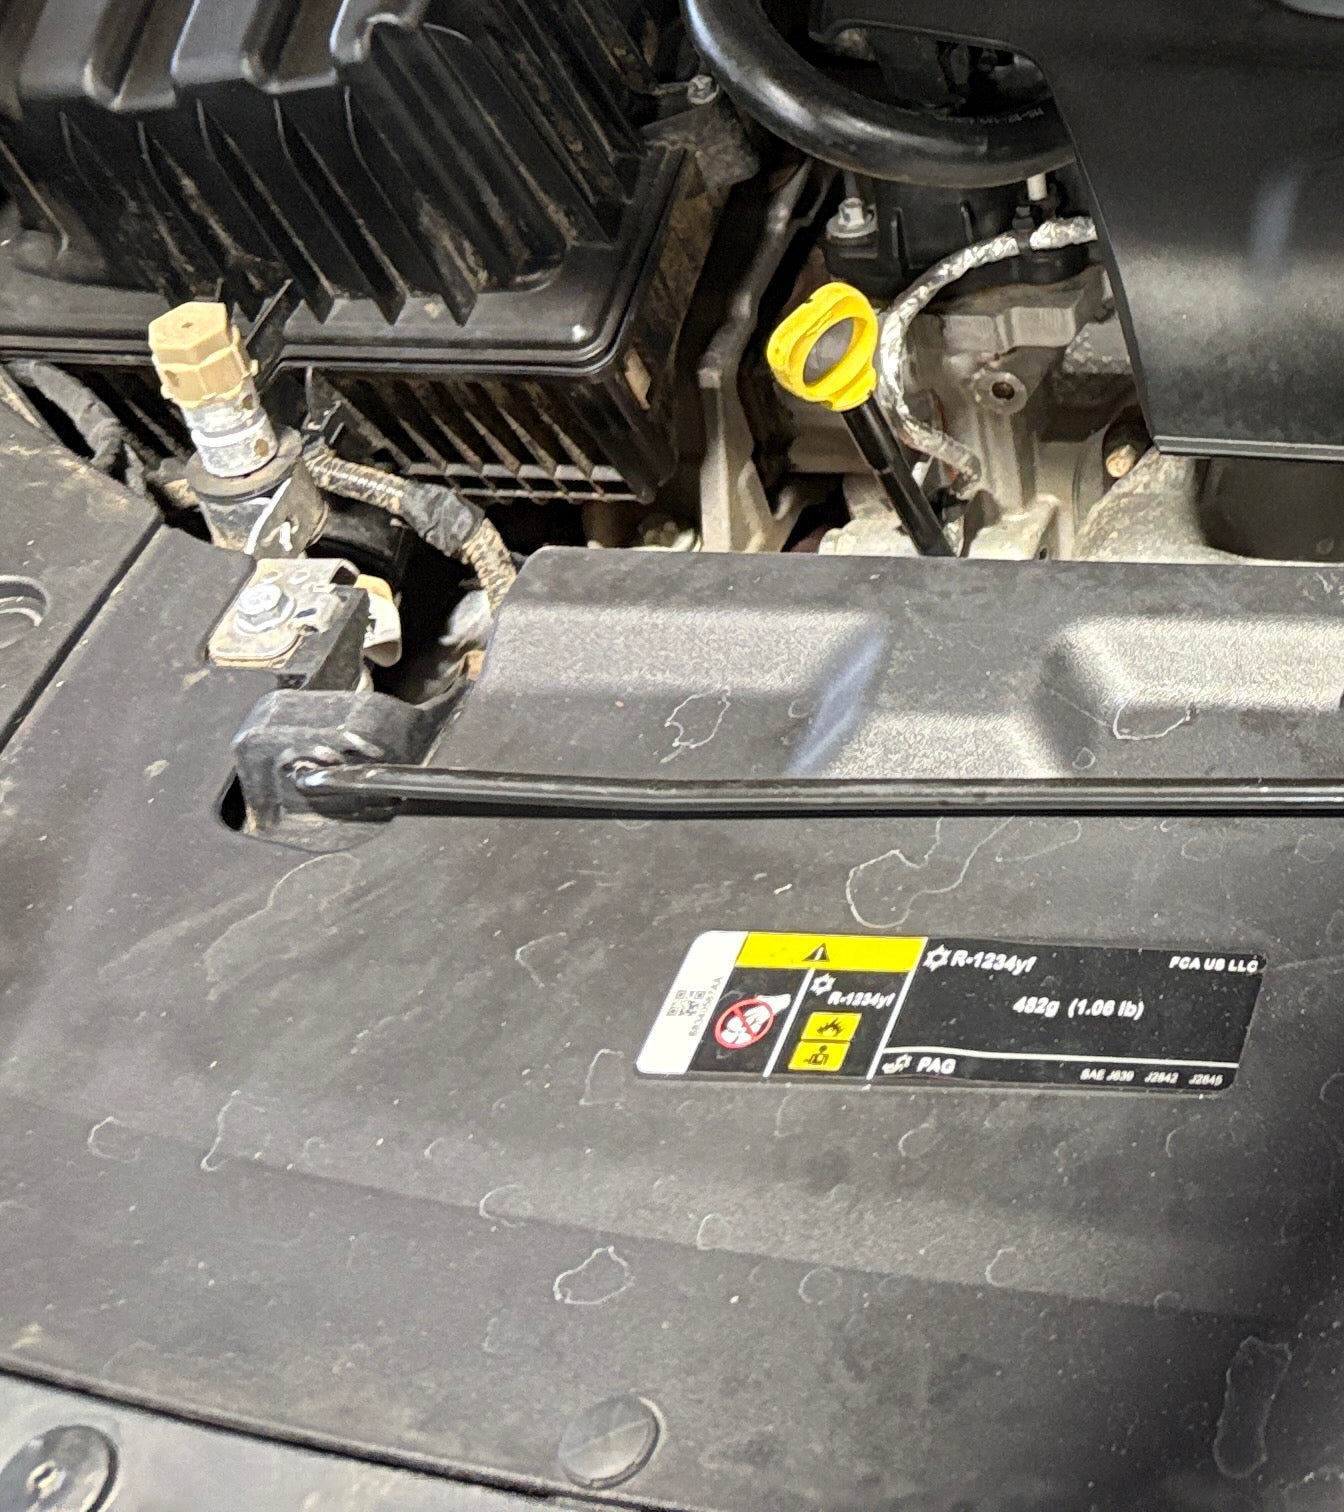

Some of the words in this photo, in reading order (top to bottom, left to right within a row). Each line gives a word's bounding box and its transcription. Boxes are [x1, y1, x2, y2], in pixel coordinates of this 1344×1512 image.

[1169, 956, 1201, 970] FCA
[1203, 958, 1226, 971] US
[1228, 959, 1259, 974] LLC
[1117, 999, 1144, 1021] lb)
[917, 1056, 957, 1075] PAG
